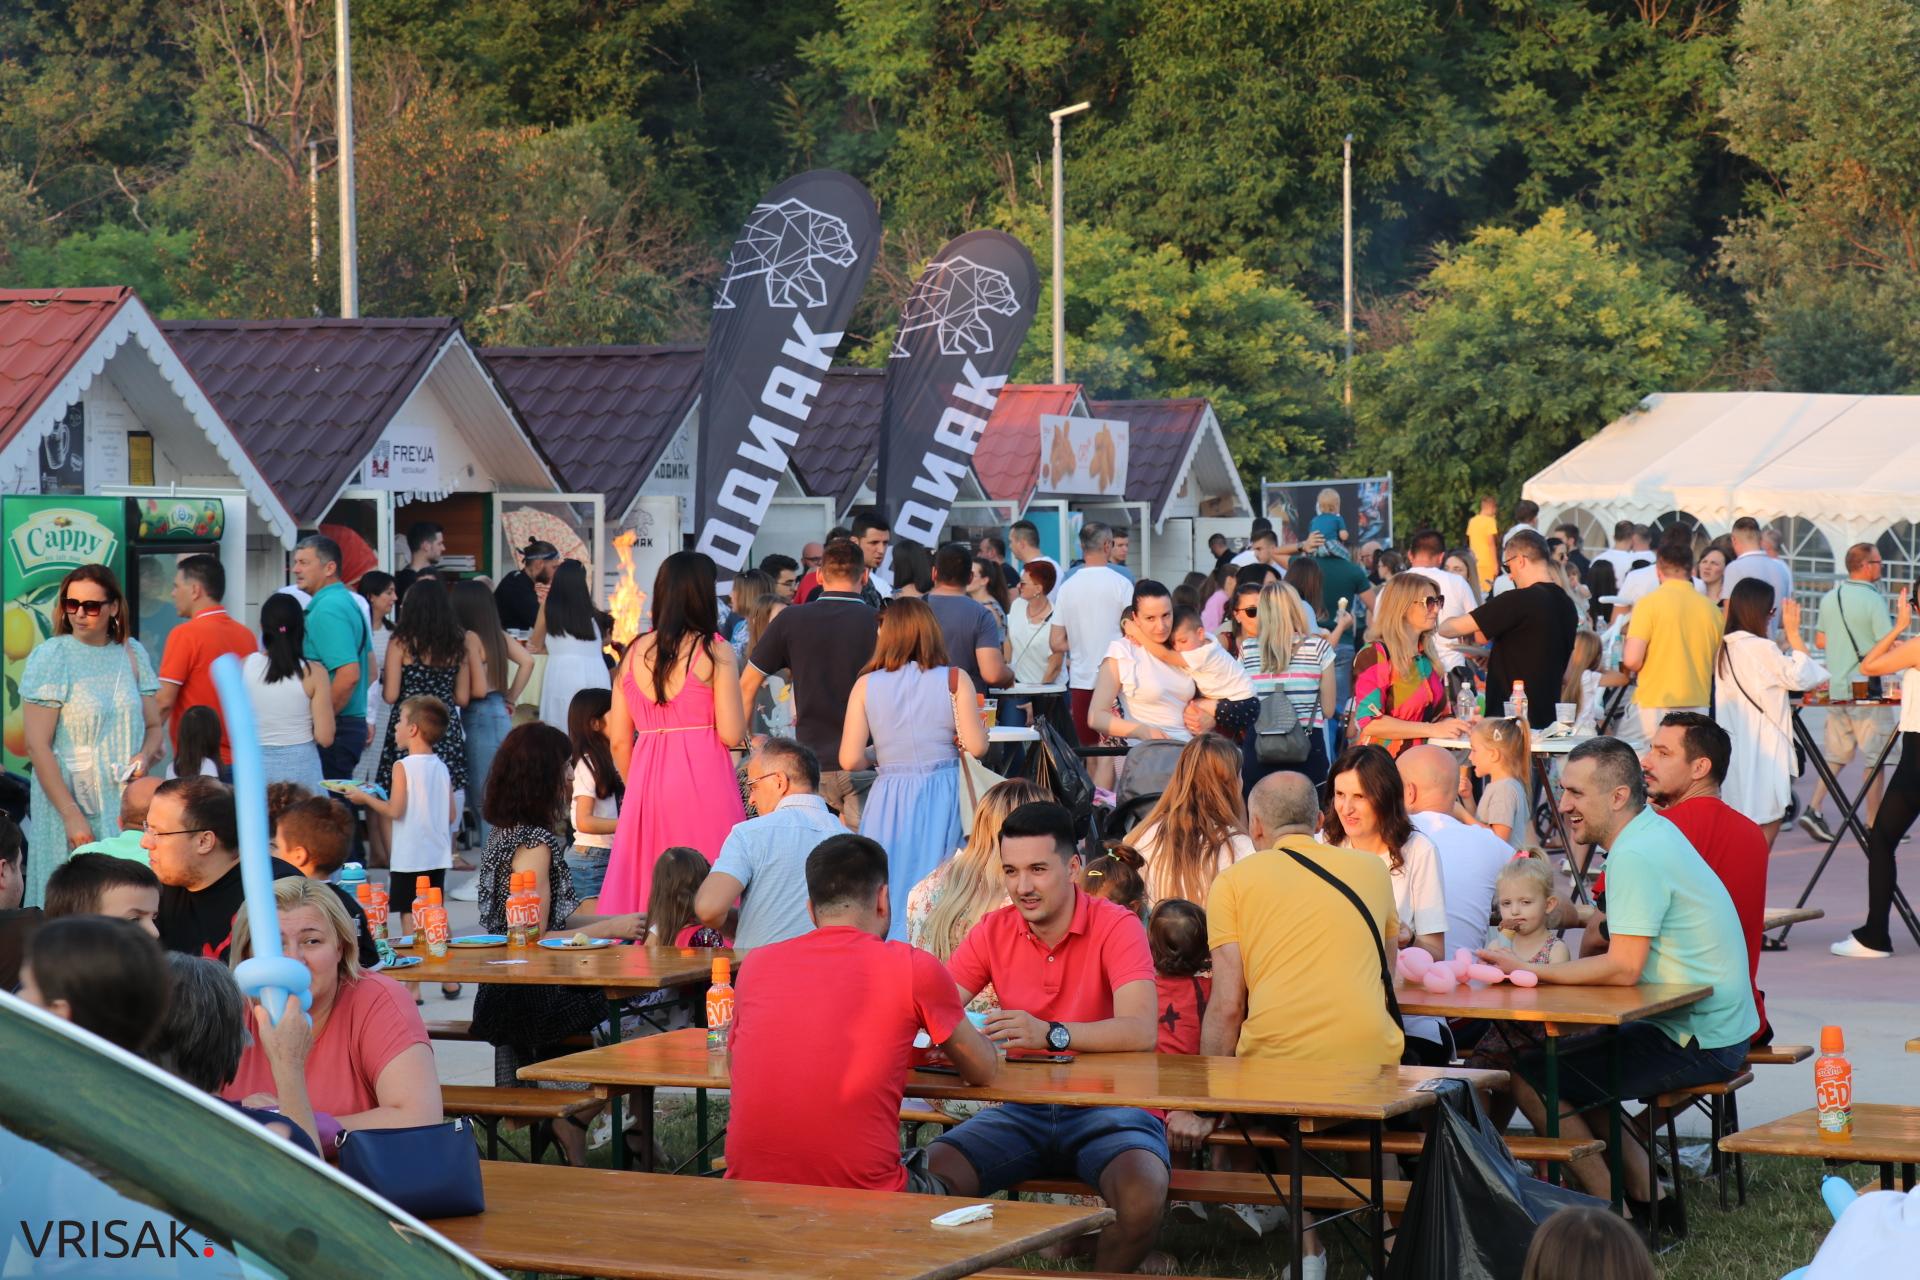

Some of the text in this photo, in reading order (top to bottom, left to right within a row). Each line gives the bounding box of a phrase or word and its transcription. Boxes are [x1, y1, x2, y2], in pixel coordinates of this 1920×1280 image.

[393, 445, 434, 462] FREYJA
[27, 527, 103, 557] Cappy
[1817, 1078, 1851, 1112] CED
